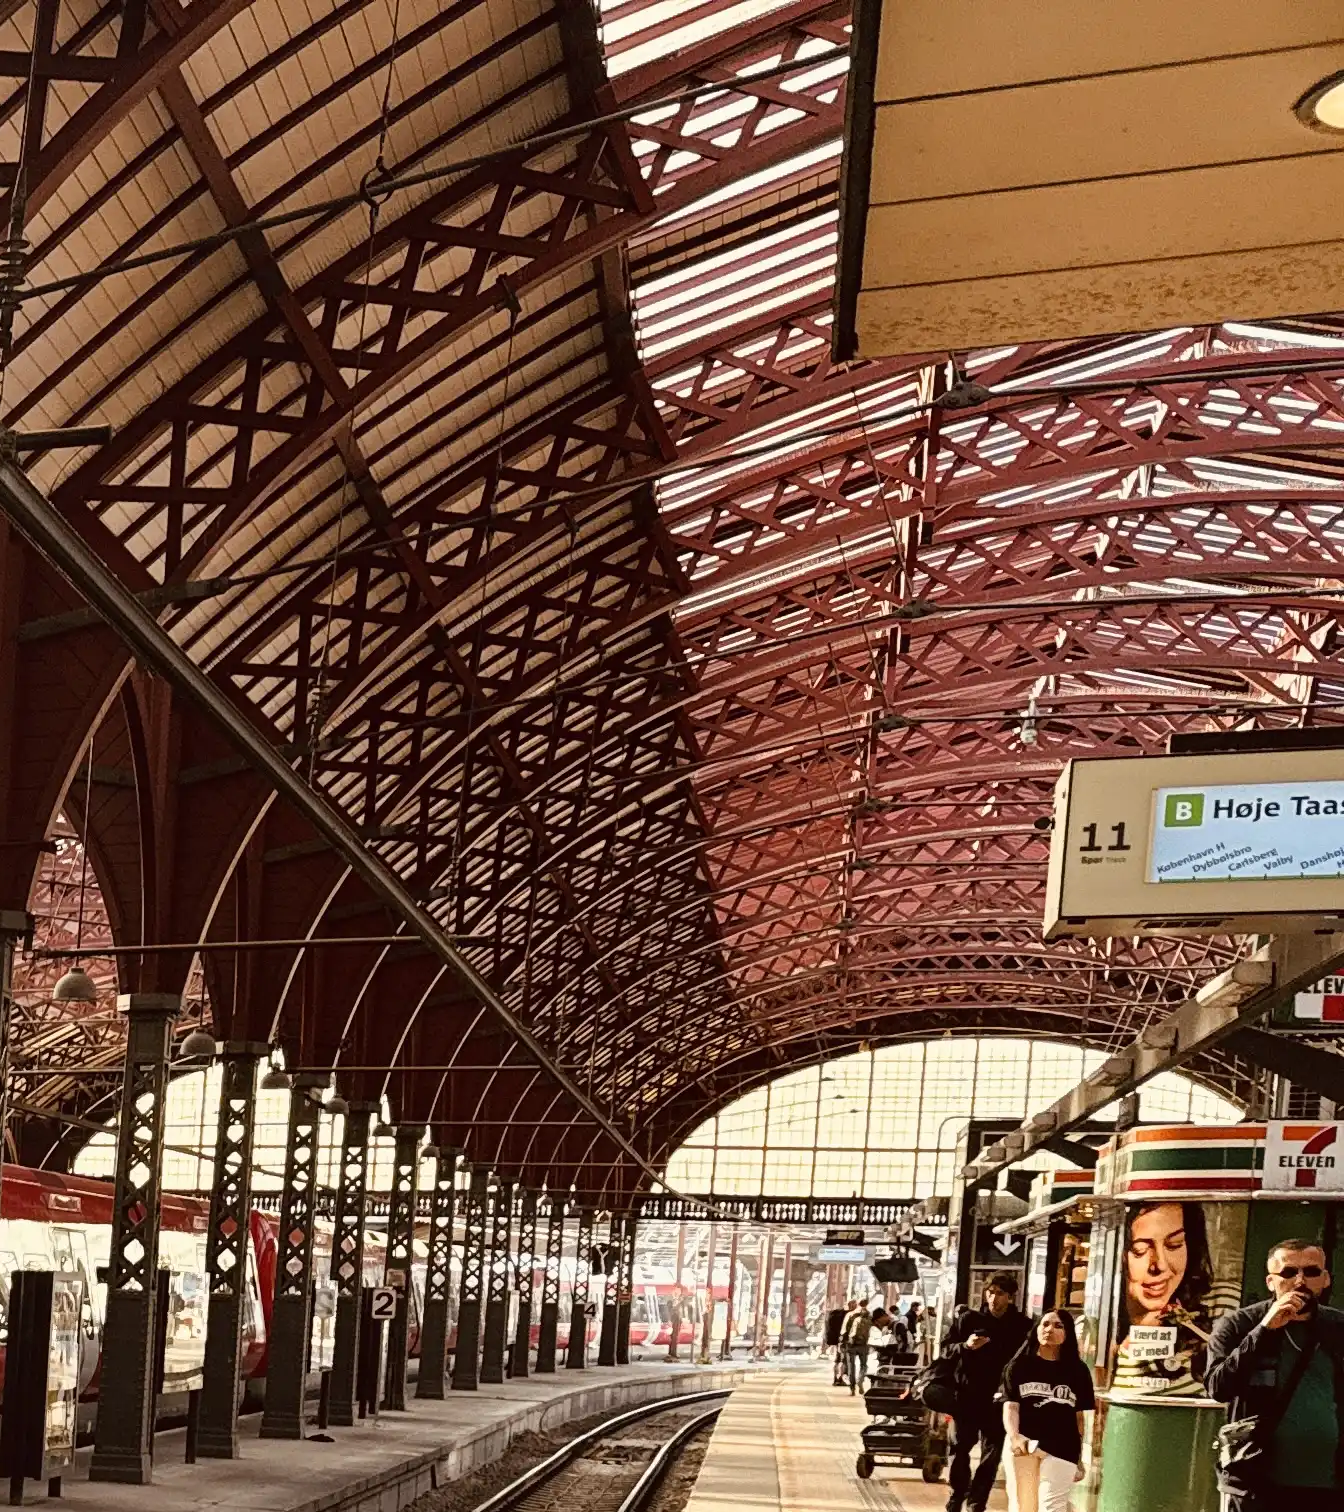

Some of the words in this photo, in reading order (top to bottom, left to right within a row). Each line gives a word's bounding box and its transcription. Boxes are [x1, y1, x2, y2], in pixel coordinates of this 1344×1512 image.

[1175, 801, 1192, 820] B
[1213, 797, 1280, 823] Høje
[1079, 821, 1131, 851] 11
[1156, 847, 1214, 875] København
[1216, 841, 1226, 852] H
[1192, 845, 1252, 873] Dybbølsbro
[1228, 848, 1278, 872] Carlsberg
[1263, 855, 1294, 871] Valby
[1282, 1126, 1338, 1188] 7
[374, 1291, 394, 1316] 2
[584, 1303, 597, 1317] 4
[1159, 1331, 1172, 1341] at
[1145, 1344, 1170, 1357] med
